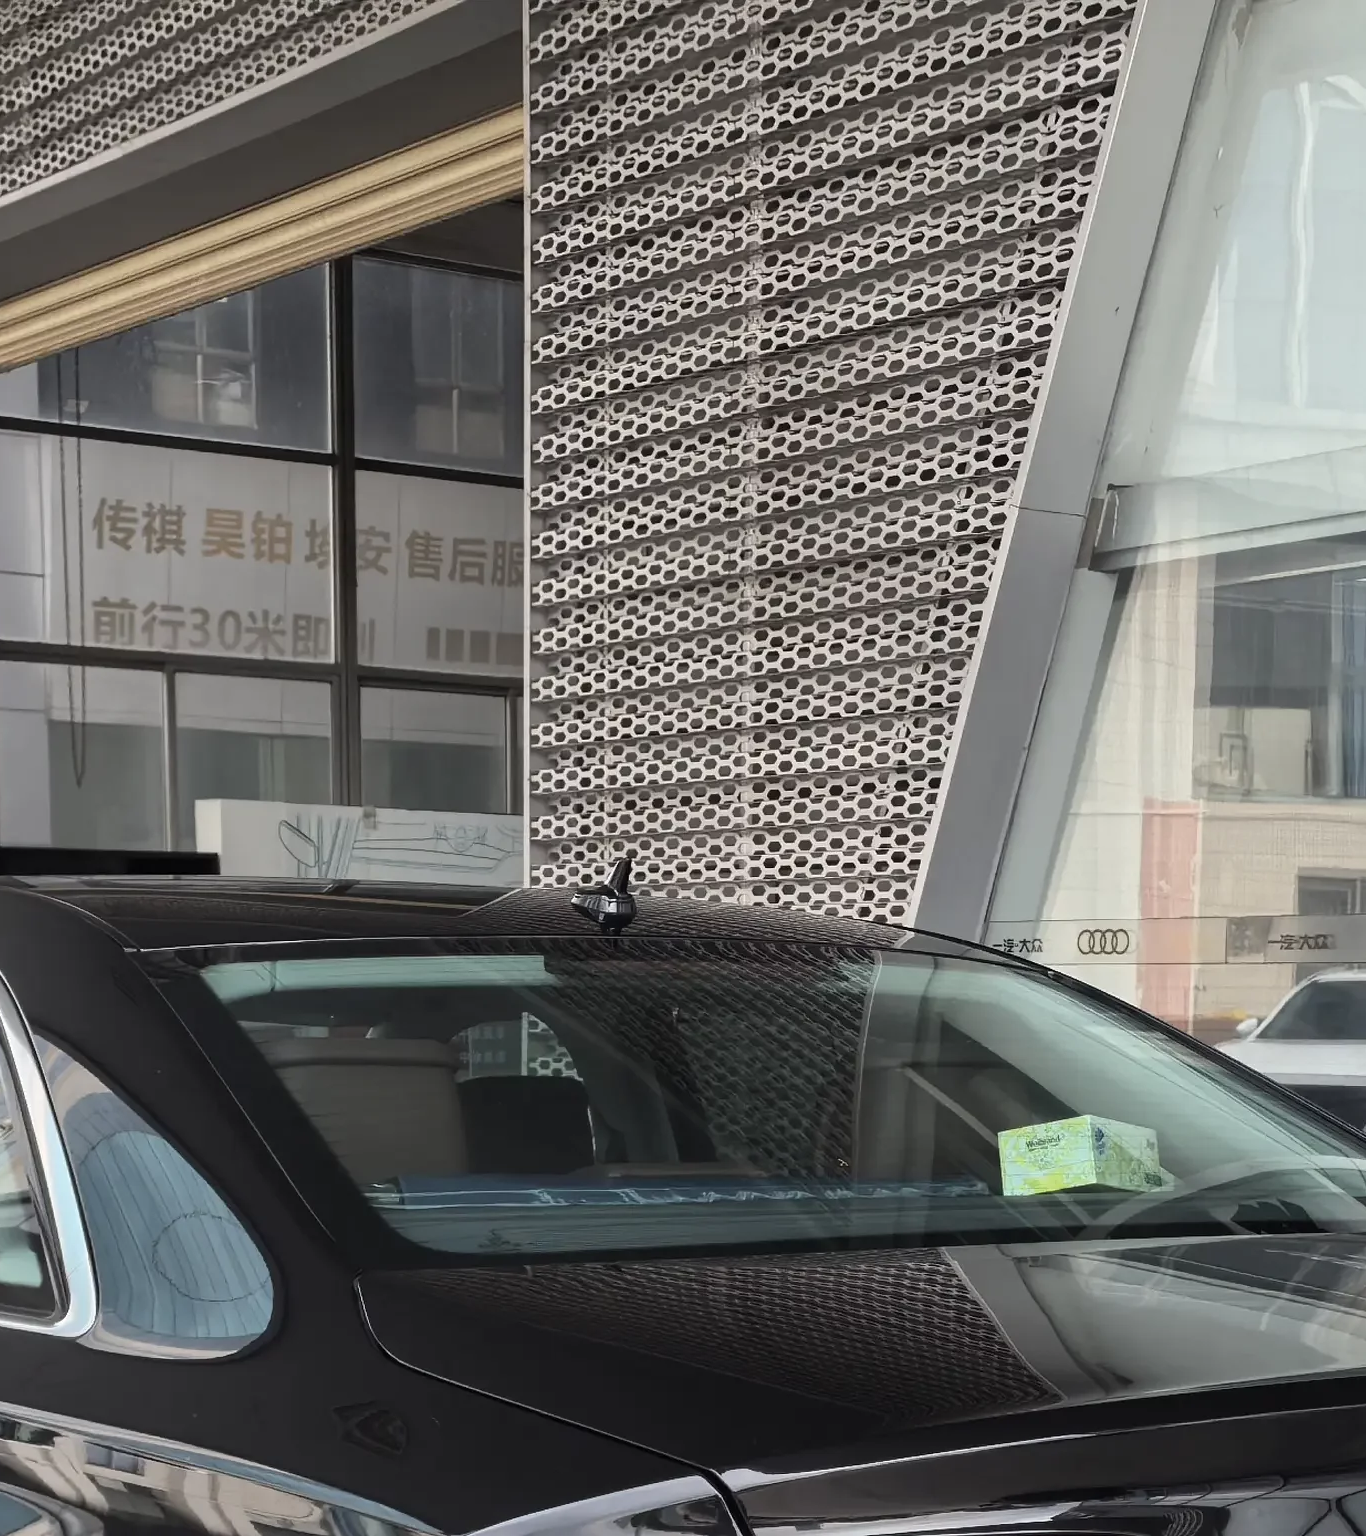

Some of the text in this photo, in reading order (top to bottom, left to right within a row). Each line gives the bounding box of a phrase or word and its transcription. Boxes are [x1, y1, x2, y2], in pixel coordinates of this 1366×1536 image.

[92, 497, 187, 557] 传祺
[201, 507, 294, 565] 昊铂
[405, 529, 524, 588] 售后服
